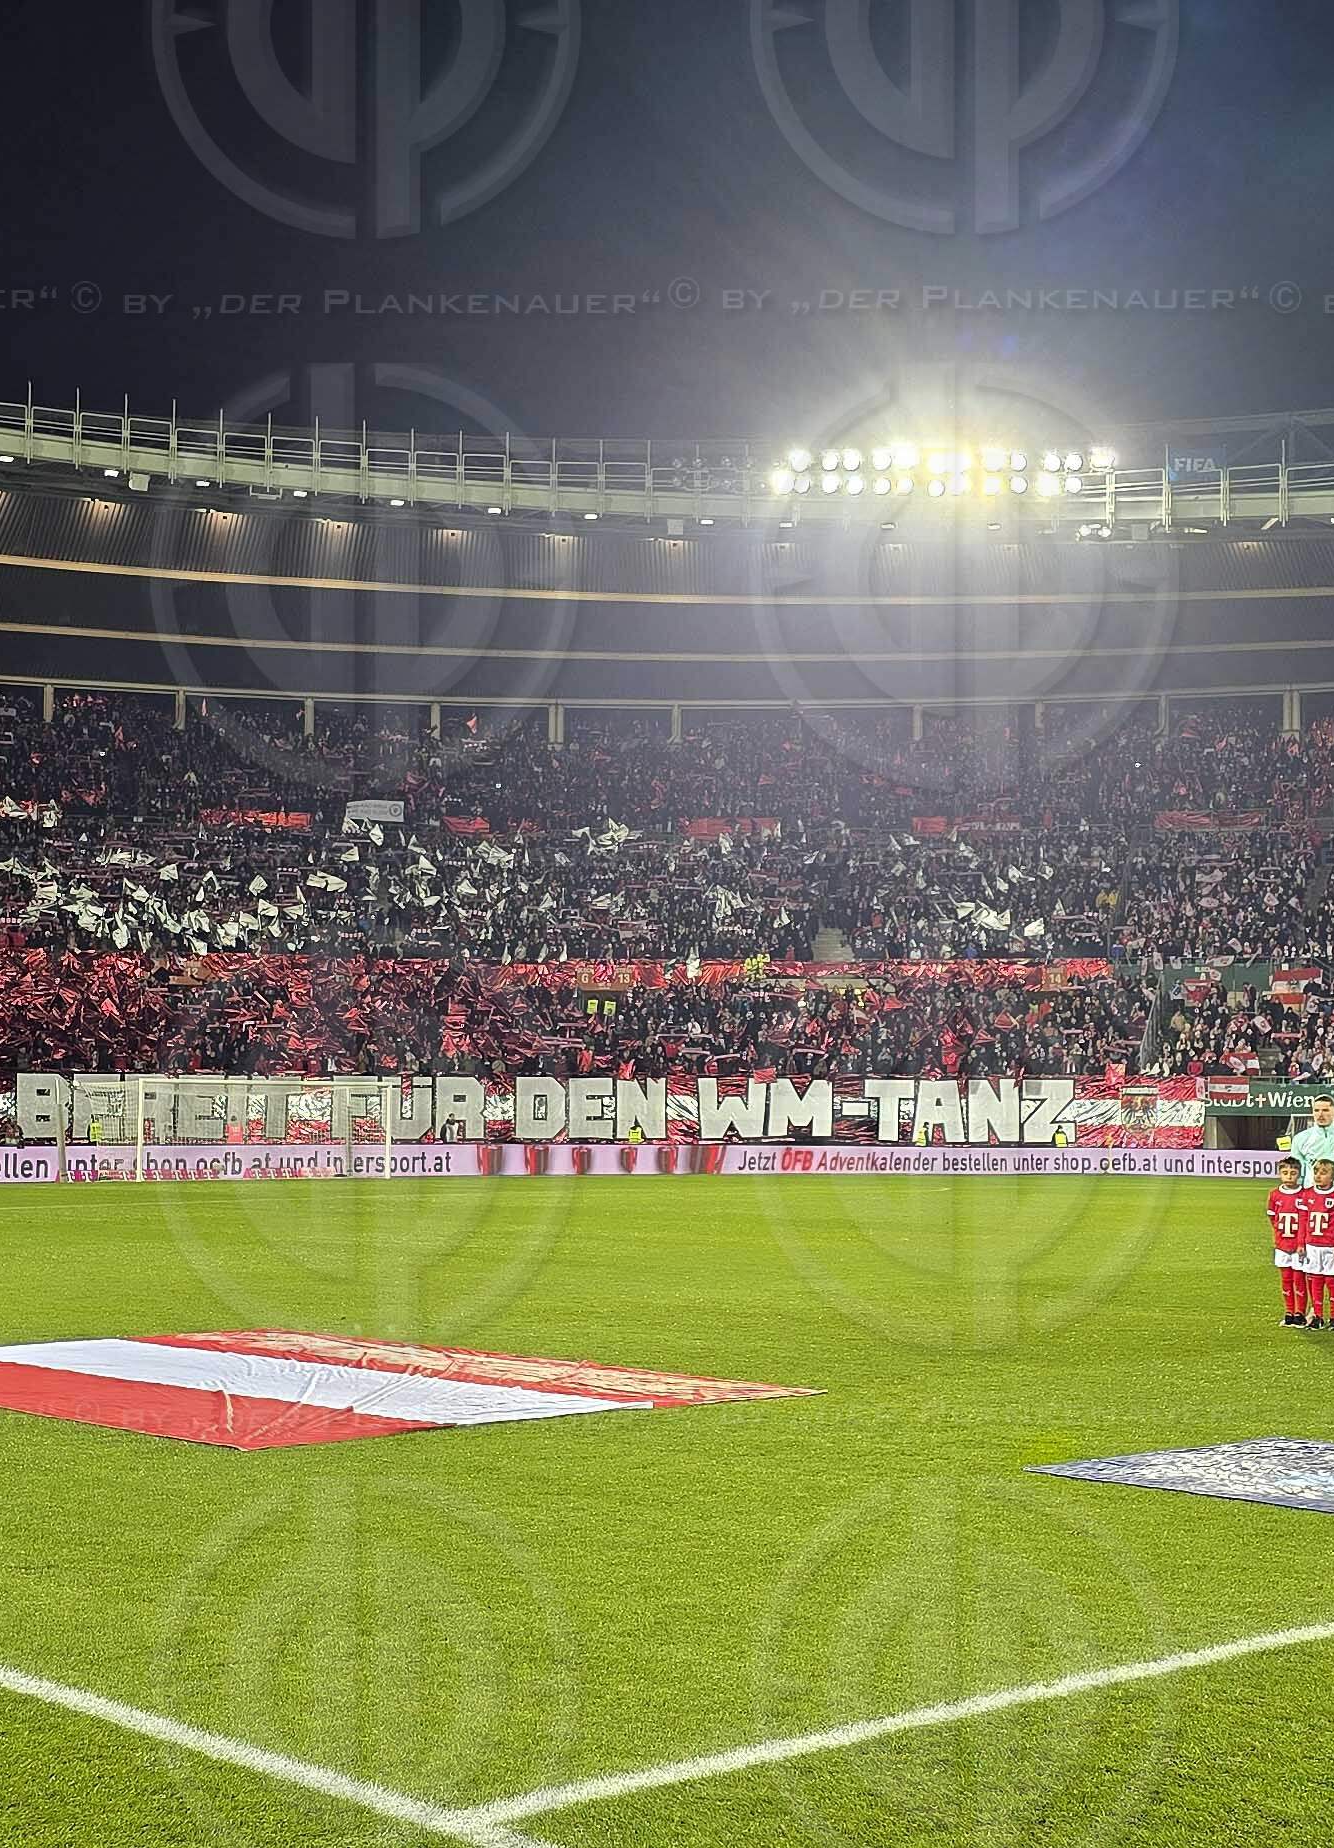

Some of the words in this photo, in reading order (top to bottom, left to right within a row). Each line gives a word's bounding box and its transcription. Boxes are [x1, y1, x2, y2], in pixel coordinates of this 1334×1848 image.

[1174, 457, 1216, 472] FIFA
[515, 1075, 667, 1139] DEN
[698, 1077, 1076, 1144] WM-TANZ
[738, 1152, 777, 1171] Jetzt
[781, 1149, 813, 1171] ÖFB
[817, 1152, 937, 1172] Adventkalender
[943, 1153, 1008, 1172] bestellen
[1013, 1156, 1048, 1172] unter
[1053, 1154, 1158, 1175] shop.oefb.at
[1167, 1155, 1197, 1173] und
[1278, 1212, 1299, 1238] T
[1310, 1211, 1329, 1236] T
